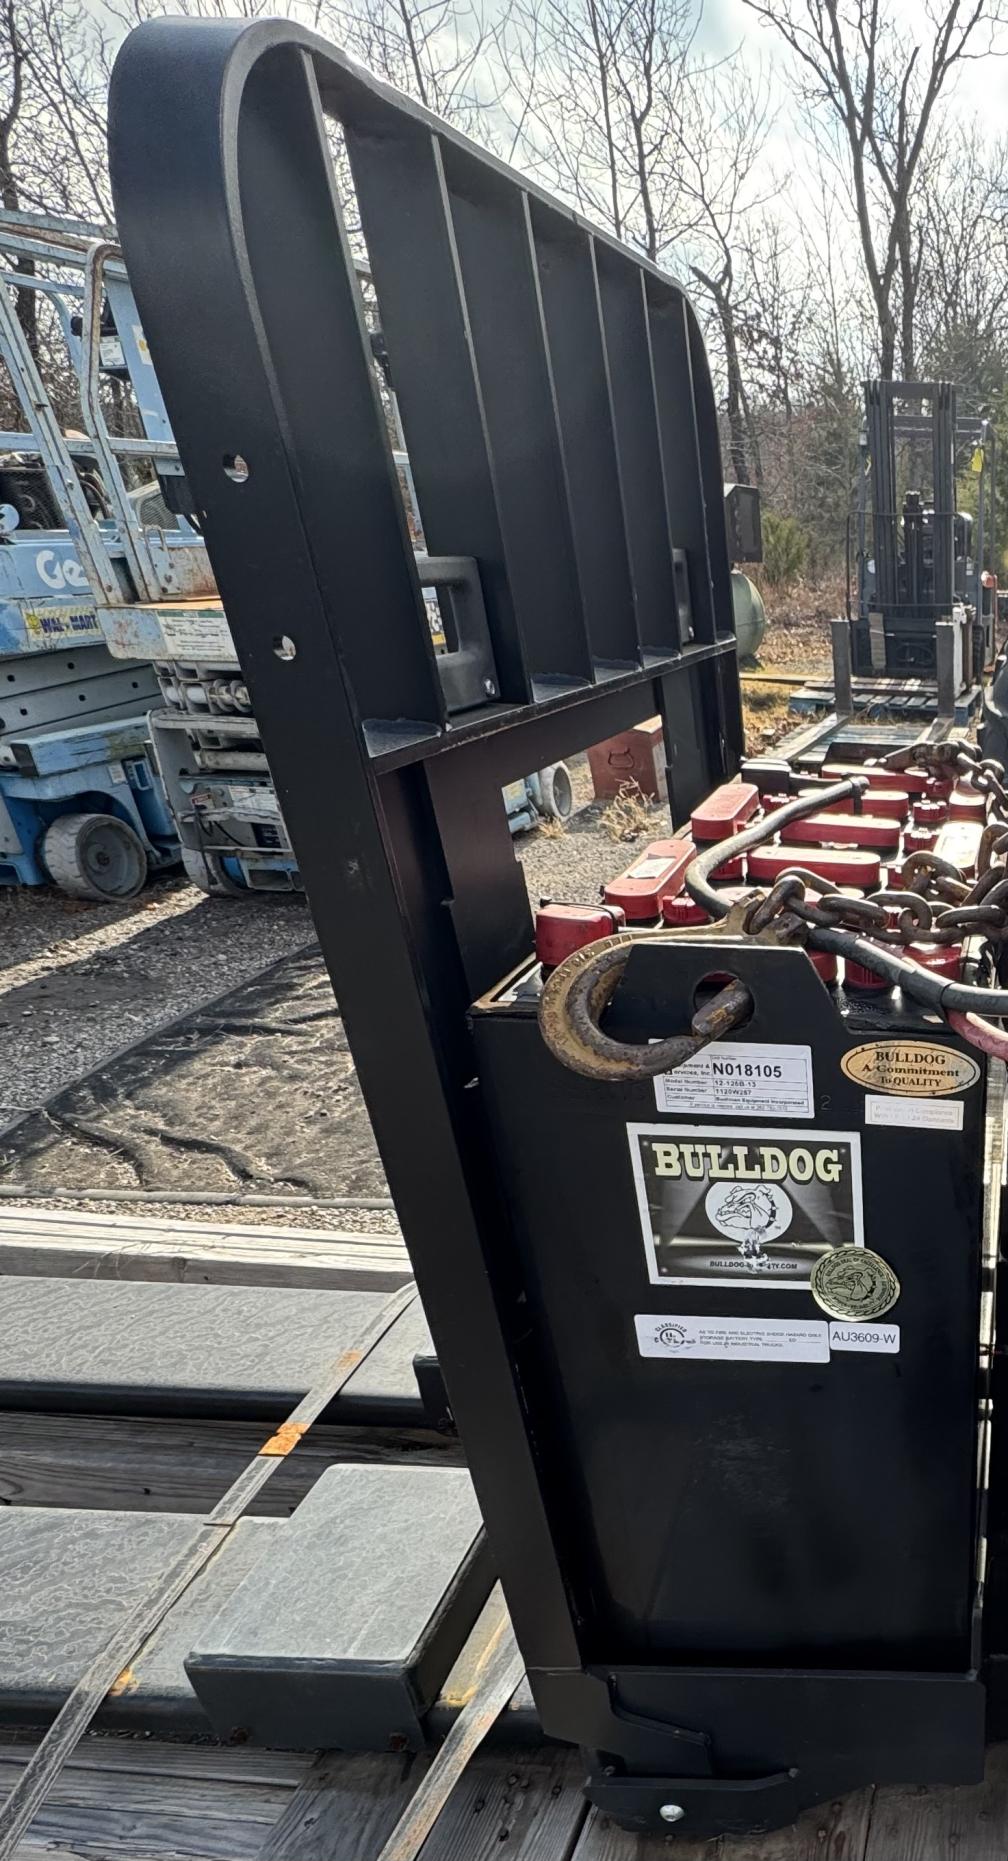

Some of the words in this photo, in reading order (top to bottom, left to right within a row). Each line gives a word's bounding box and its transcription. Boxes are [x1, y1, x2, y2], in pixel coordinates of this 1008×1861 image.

[875, 1051, 945, 1065] BULLDOG
[713, 1063, 782, 1078] N018105
[862, 1064, 871, 1072] A
[876, 1065, 960, 1077] Commitment
[893, 1078, 941, 1087] QUALITY
[652, 1143, 843, 1183] BULLDOG
[832, 1332, 896, 1344] AU3609-W
